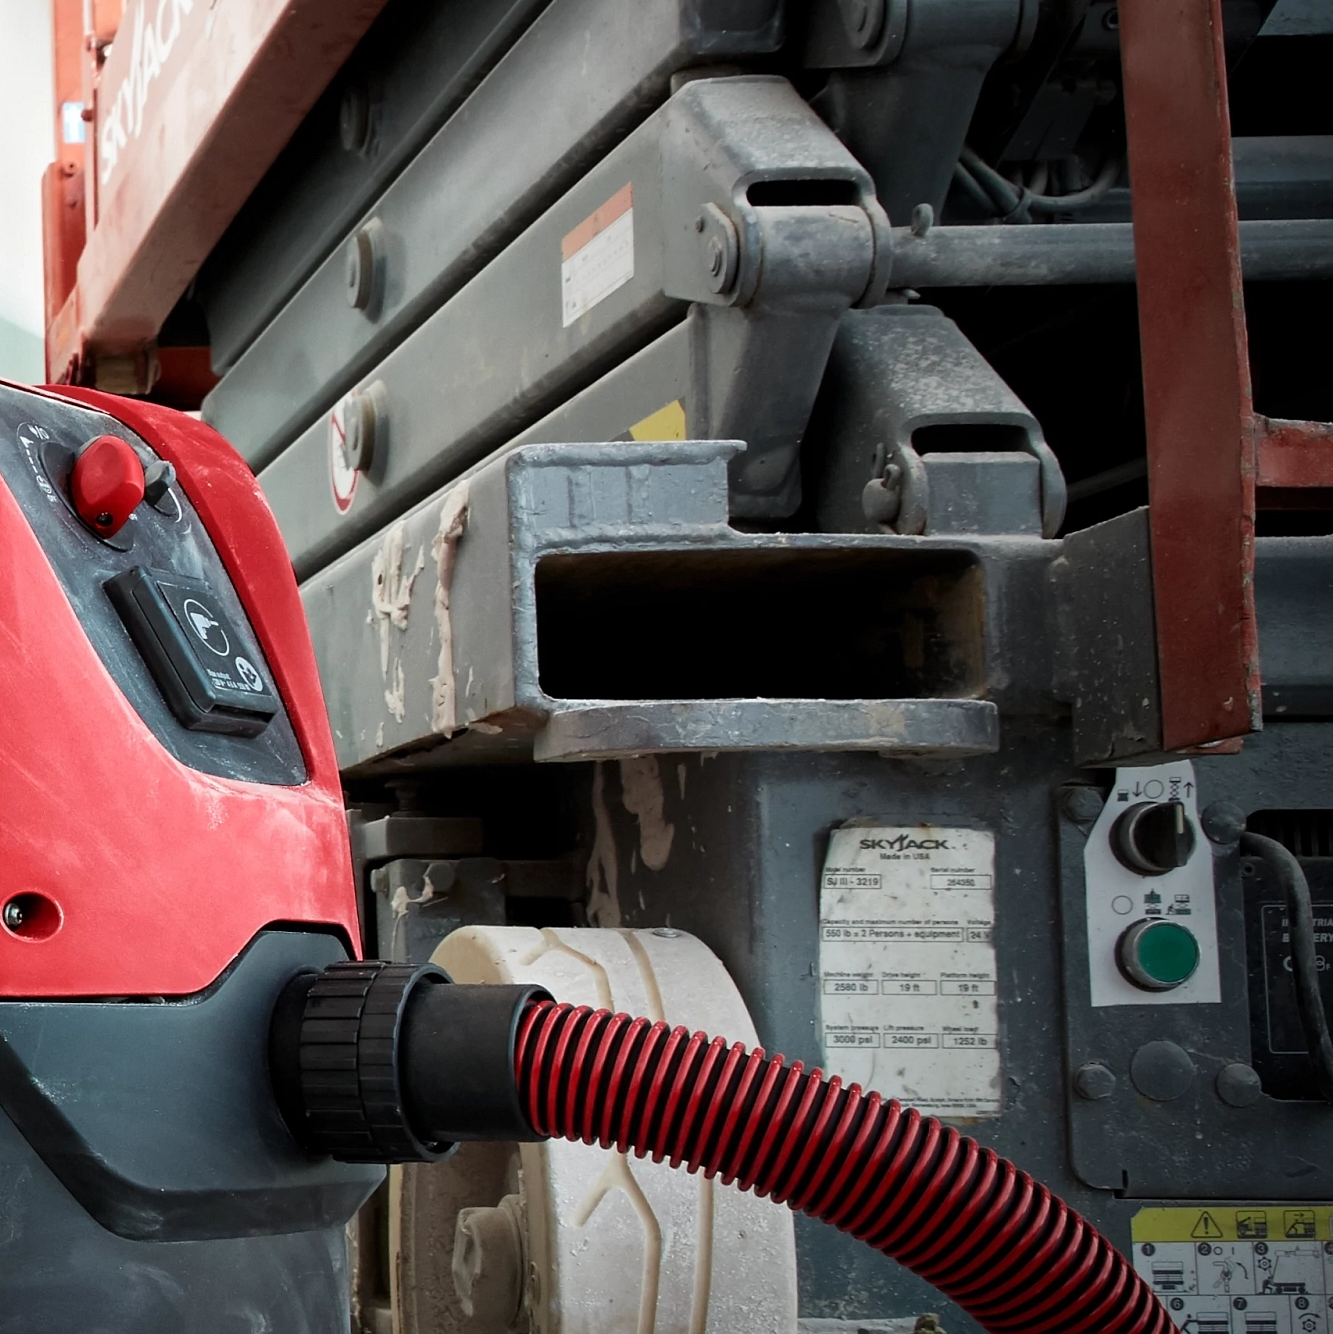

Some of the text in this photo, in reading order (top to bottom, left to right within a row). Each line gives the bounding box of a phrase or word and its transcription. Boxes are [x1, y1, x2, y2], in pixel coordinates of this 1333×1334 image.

[859, 833, 950, 852] SKYJACK
[826, 877, 838, 886] SJ
[856, 877, 879, 886] 3219
[825, 930, 841, 938] 550
[843, 930, 851, 938] lb
[861, 930, 867, 938] 2
[869, 930, 904, 938] Persons
[914, 930, 960, 940] equipment
[970, 931, 981, 939] 24
[834, 983, 868, 991] 2580 lb
[899, 984, 920, 992] 19 ft
[958, 984, 979, 992] 19 ft
[833, 1035, 873, 1046] 3000 psi
[892, 1036, 931, 1046] 2400 psi
[954, 1037, 987, 1045] 1252 lb
